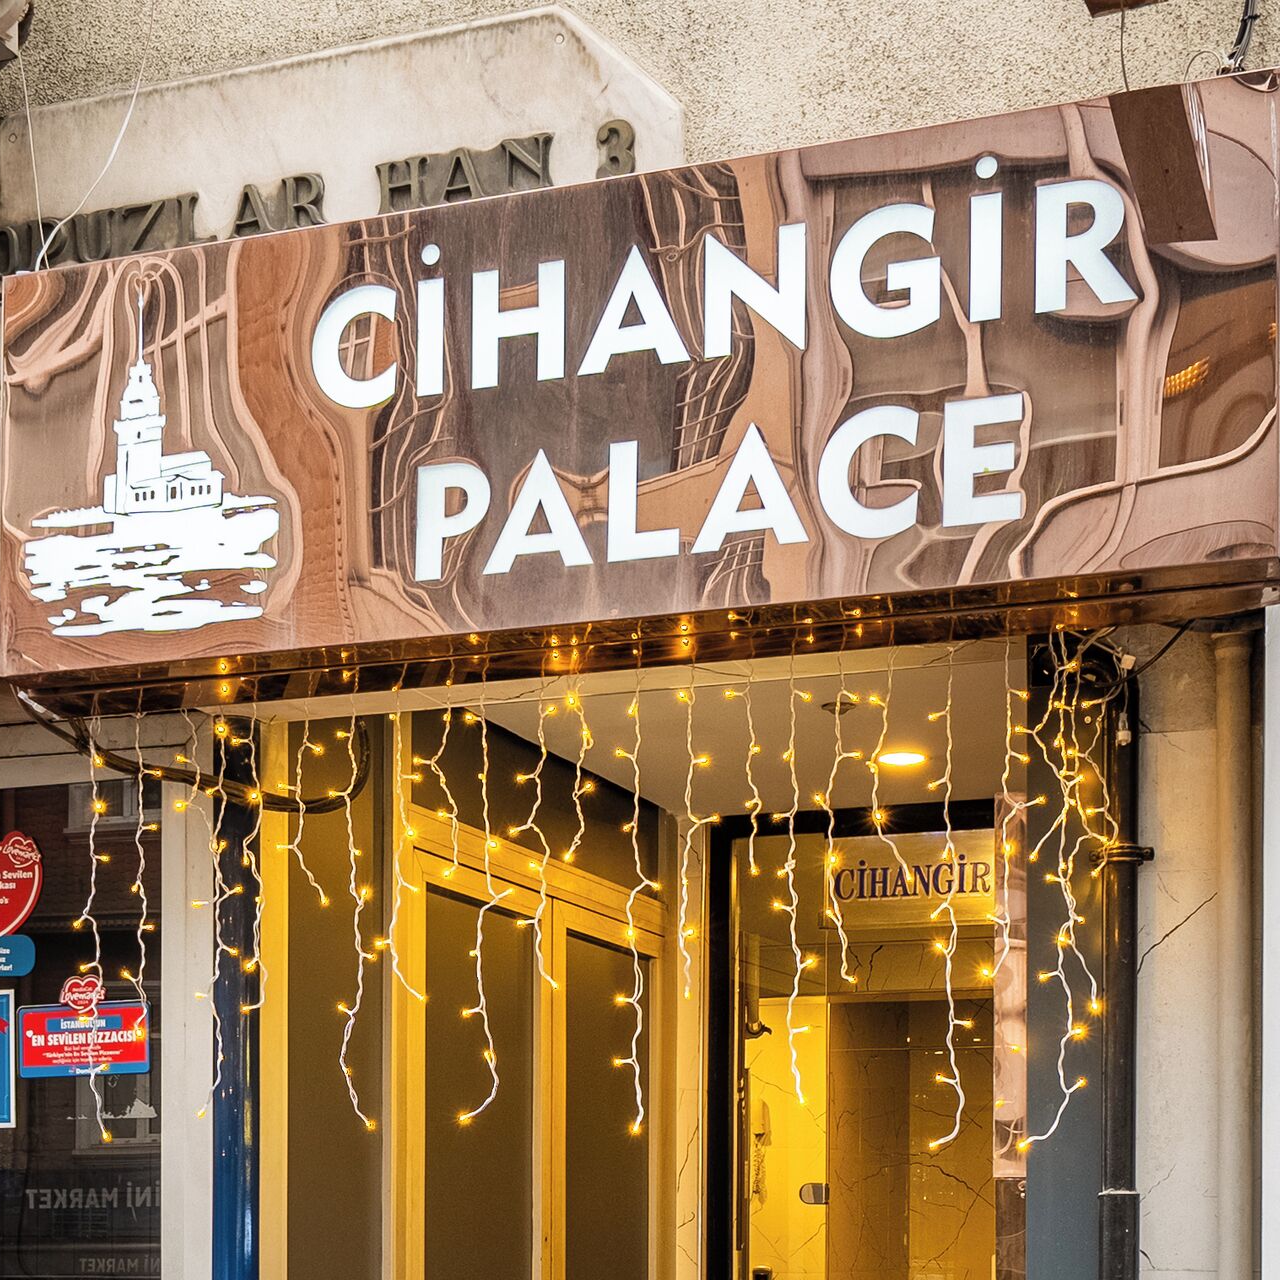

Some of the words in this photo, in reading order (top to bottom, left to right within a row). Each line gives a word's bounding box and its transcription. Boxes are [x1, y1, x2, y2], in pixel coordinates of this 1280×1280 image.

[374, 131, 556, 216] HAN
[596, 118, 636, 180] 3
[310, 156, 1138, 410] CİHANGİR
[416, 393, 1028, 582] PALACE
[2, 870, 33, 879] Sevilen
[834, 853, 991, 900] CİHANGİR
[31, 1034, 45, 1046] EN
[47, 1032, 87, 1046] SEVİLEN
